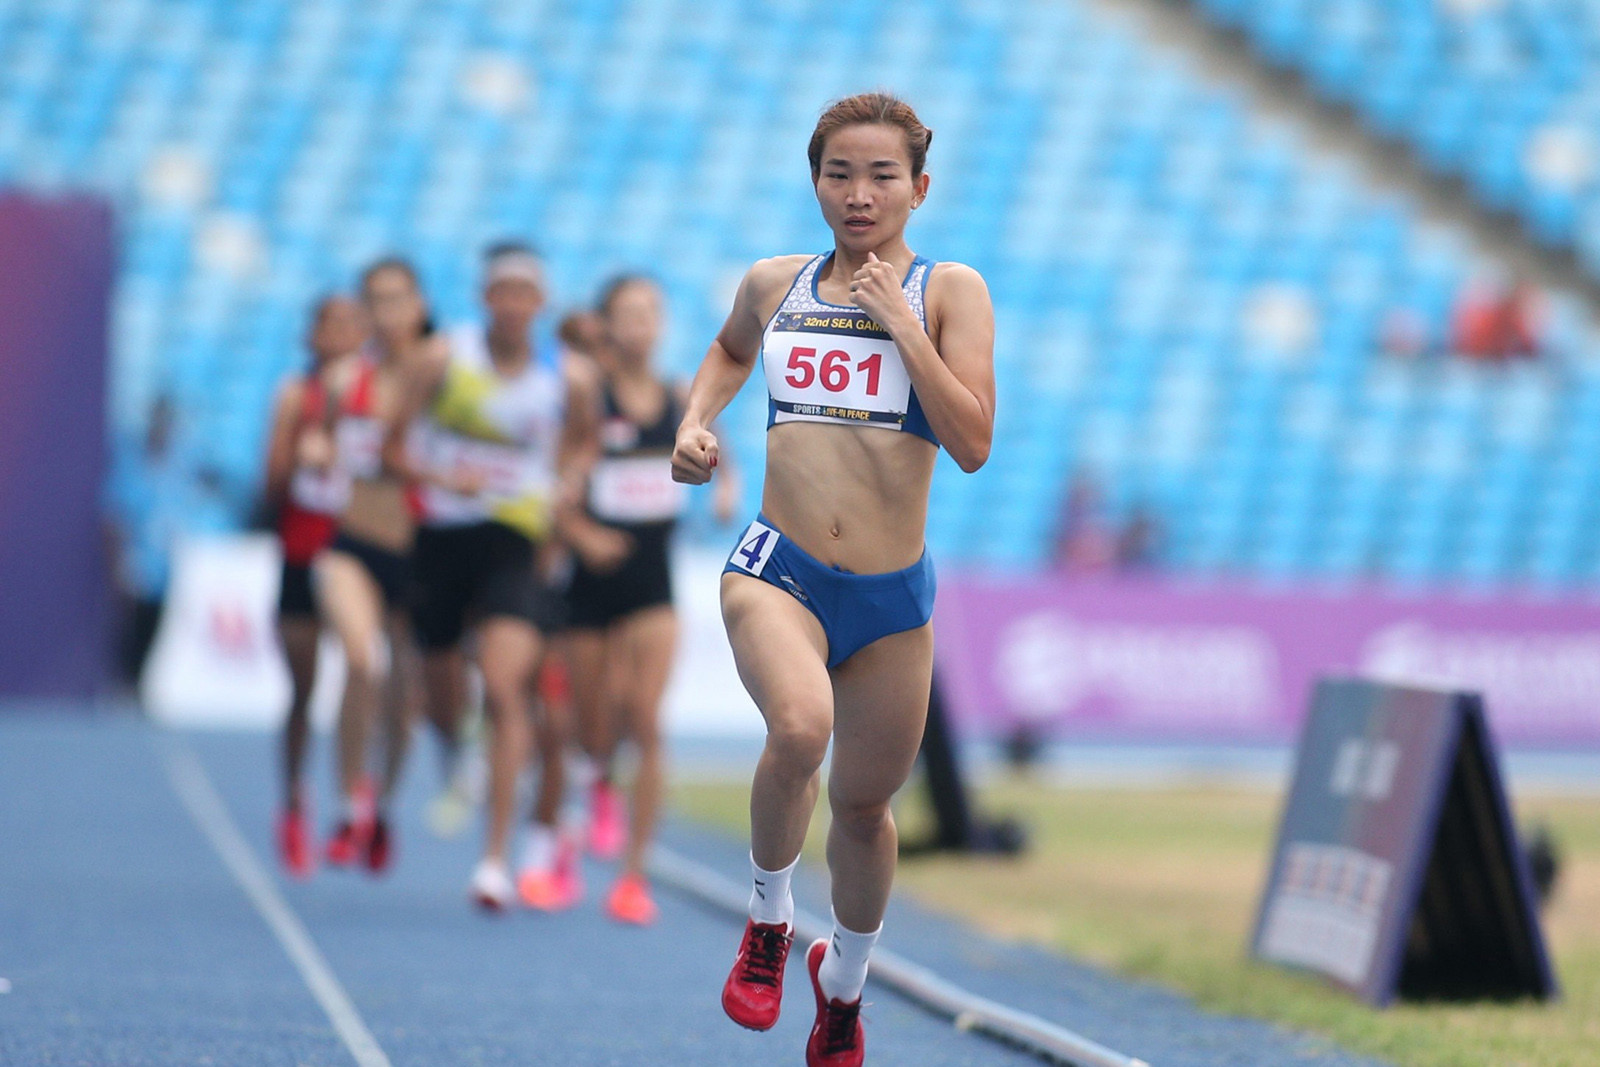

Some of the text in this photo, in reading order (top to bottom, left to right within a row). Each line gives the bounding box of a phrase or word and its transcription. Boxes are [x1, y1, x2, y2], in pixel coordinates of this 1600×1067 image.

[803, 316, 887, 333] 32nd SEA GAM
[785, 346, 883, 397] 561
[793, 404, 821, 415] SPORTS
[846, 409, 870, 421] PEACE
[739, 529, 771, 570] 4
